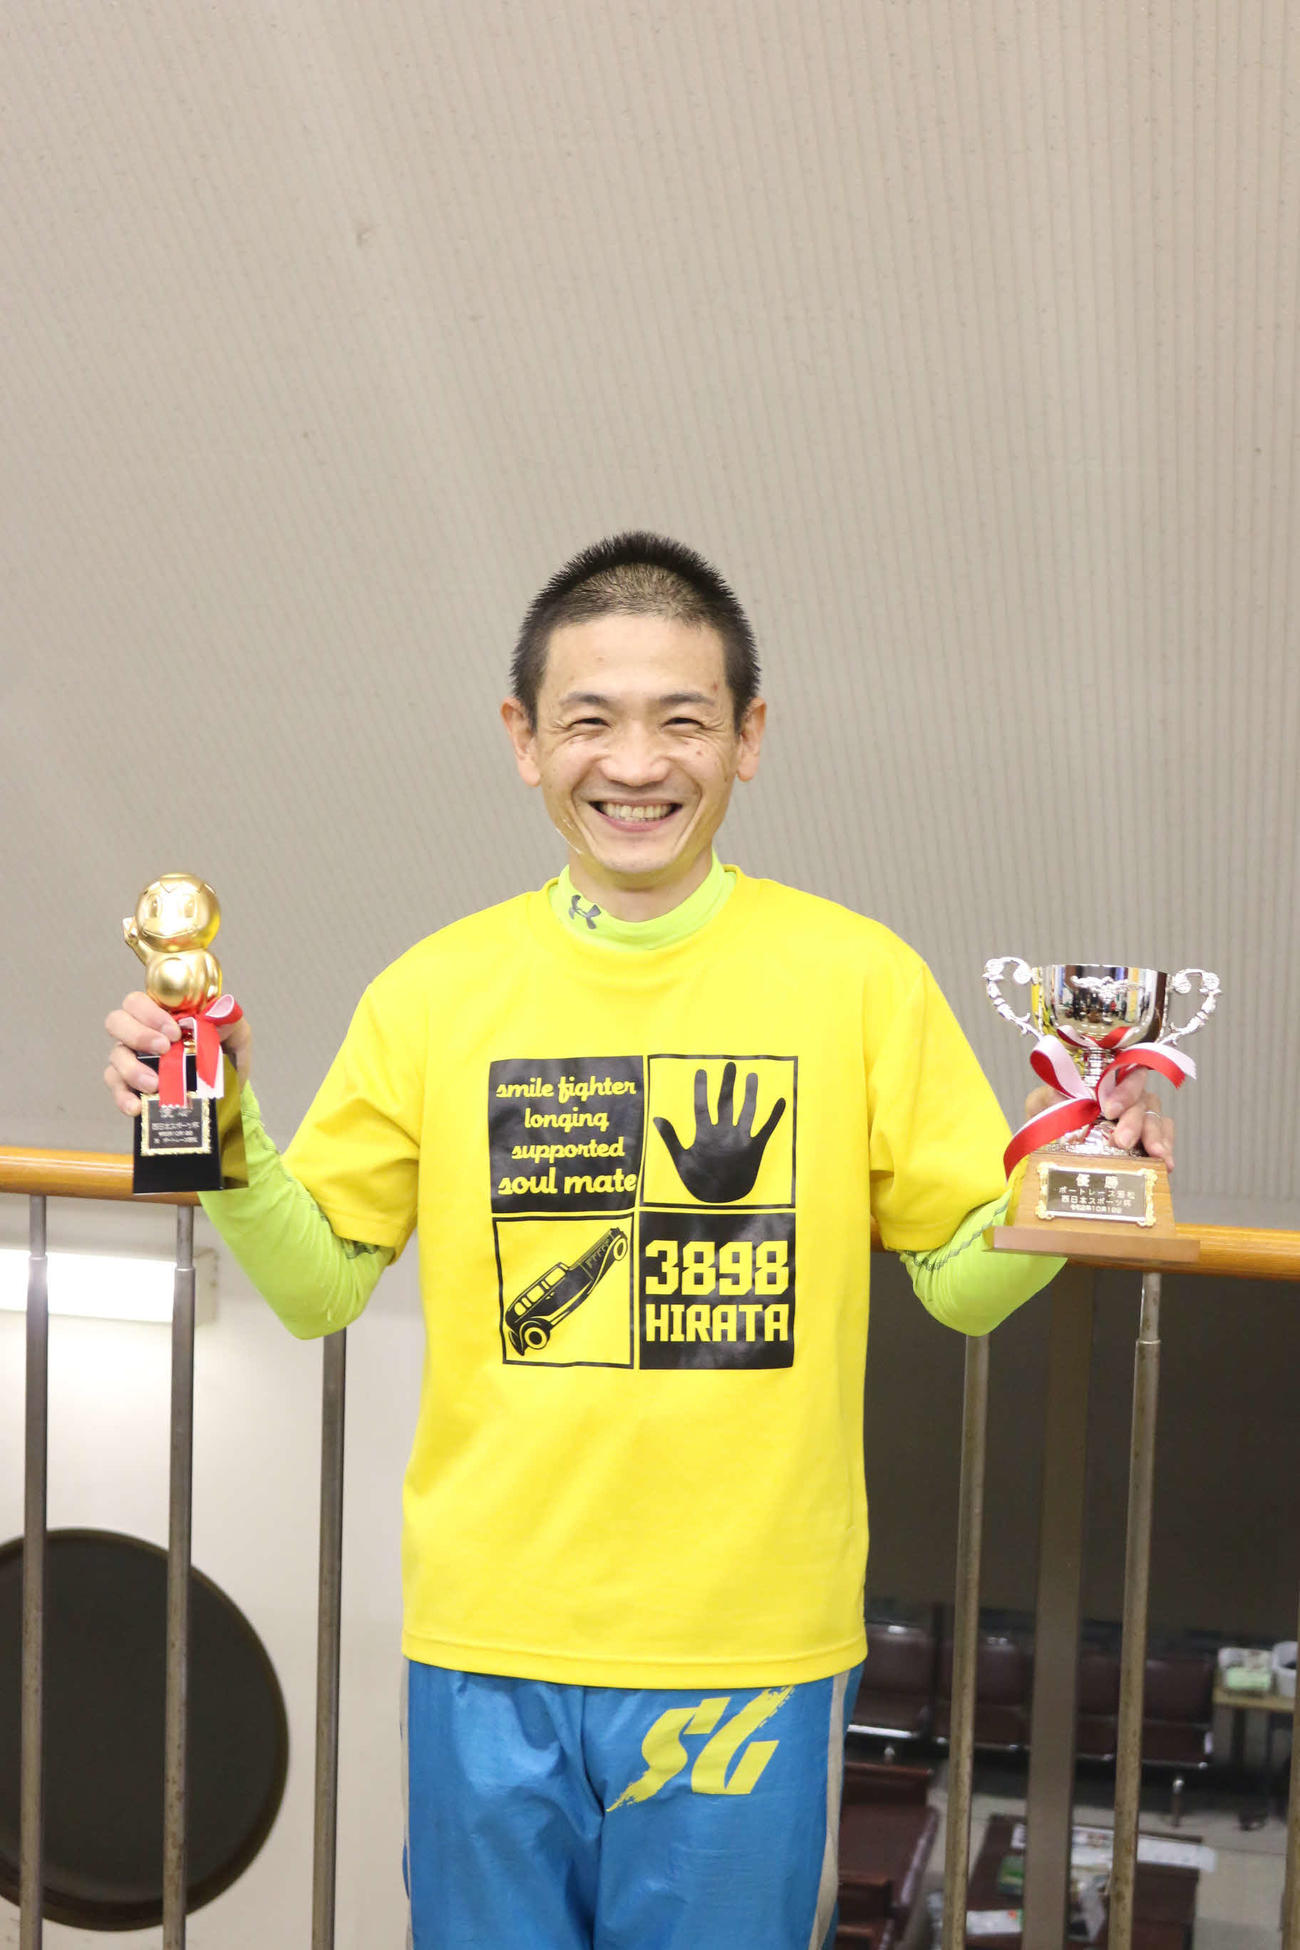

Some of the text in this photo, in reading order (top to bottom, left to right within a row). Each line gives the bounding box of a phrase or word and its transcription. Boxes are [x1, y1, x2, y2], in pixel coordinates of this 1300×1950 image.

[496, 1076, 637, 1101] smile fighter
[524, 1107, 610, 1132] longing
[512, 1136, 625, 1164] supported
[498, 1167, 638, 1195] soul mate
[645, 1240, 789, 1296] 3898
[646, 1304, 789, 1342] HIRATA
